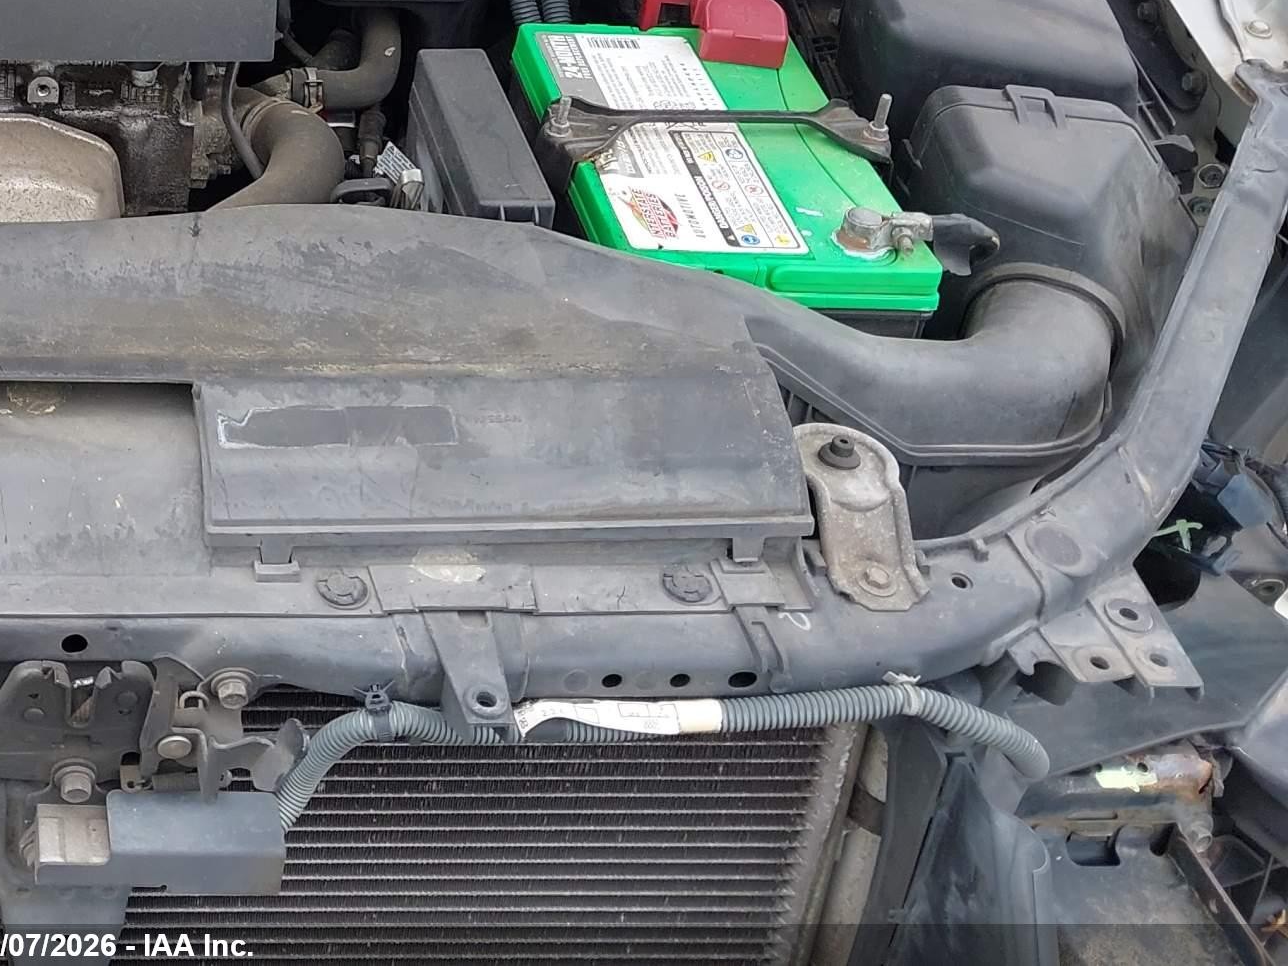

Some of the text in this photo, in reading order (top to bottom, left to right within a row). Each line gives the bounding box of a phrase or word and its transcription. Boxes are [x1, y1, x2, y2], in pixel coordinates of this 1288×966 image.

[546, 34, 583, 78] 24-MONTH
[629, 188, 664, 238] INTERSTATE
[645, 192, 677, 237] BATTERIES
[673, 193, 706, 238] AUTOMOTIVE
